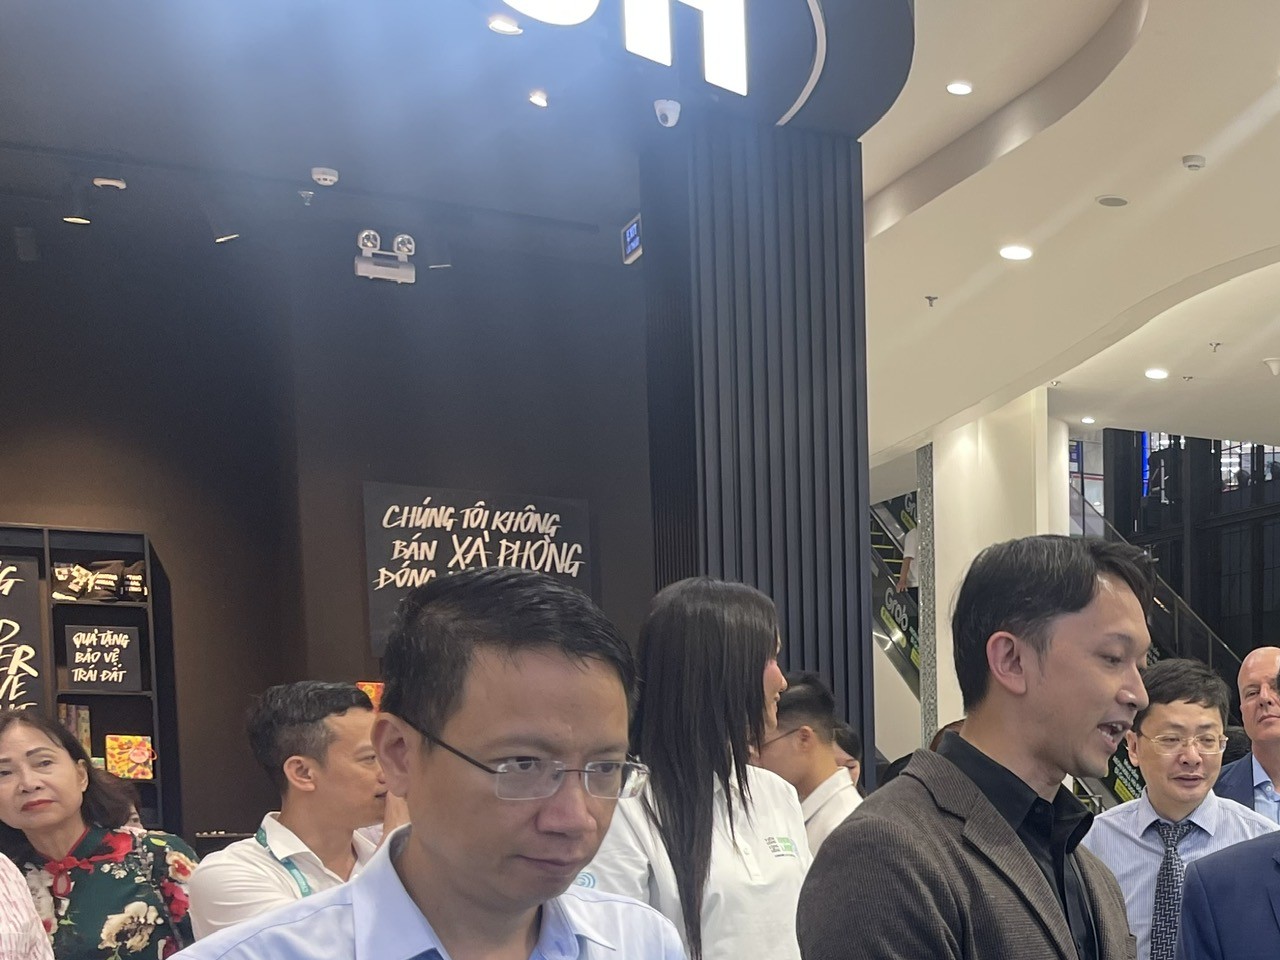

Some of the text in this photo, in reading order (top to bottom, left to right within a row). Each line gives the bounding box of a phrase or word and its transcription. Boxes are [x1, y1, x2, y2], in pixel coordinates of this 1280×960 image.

[382, 496, 562, 537] CHÚNG TÔI KHÔNG
[904, 493, 917, 521] Gr
[391, 530, 585, 577] BÁN XÀ PHÒNG
[885, 587, 908, 631] Grab
[97, 630, 130, 649] TẶNG
[75, 648, 120, 666] BẢO VỆ
[72, 663, 127, 683] TRÁI ĐẤT
